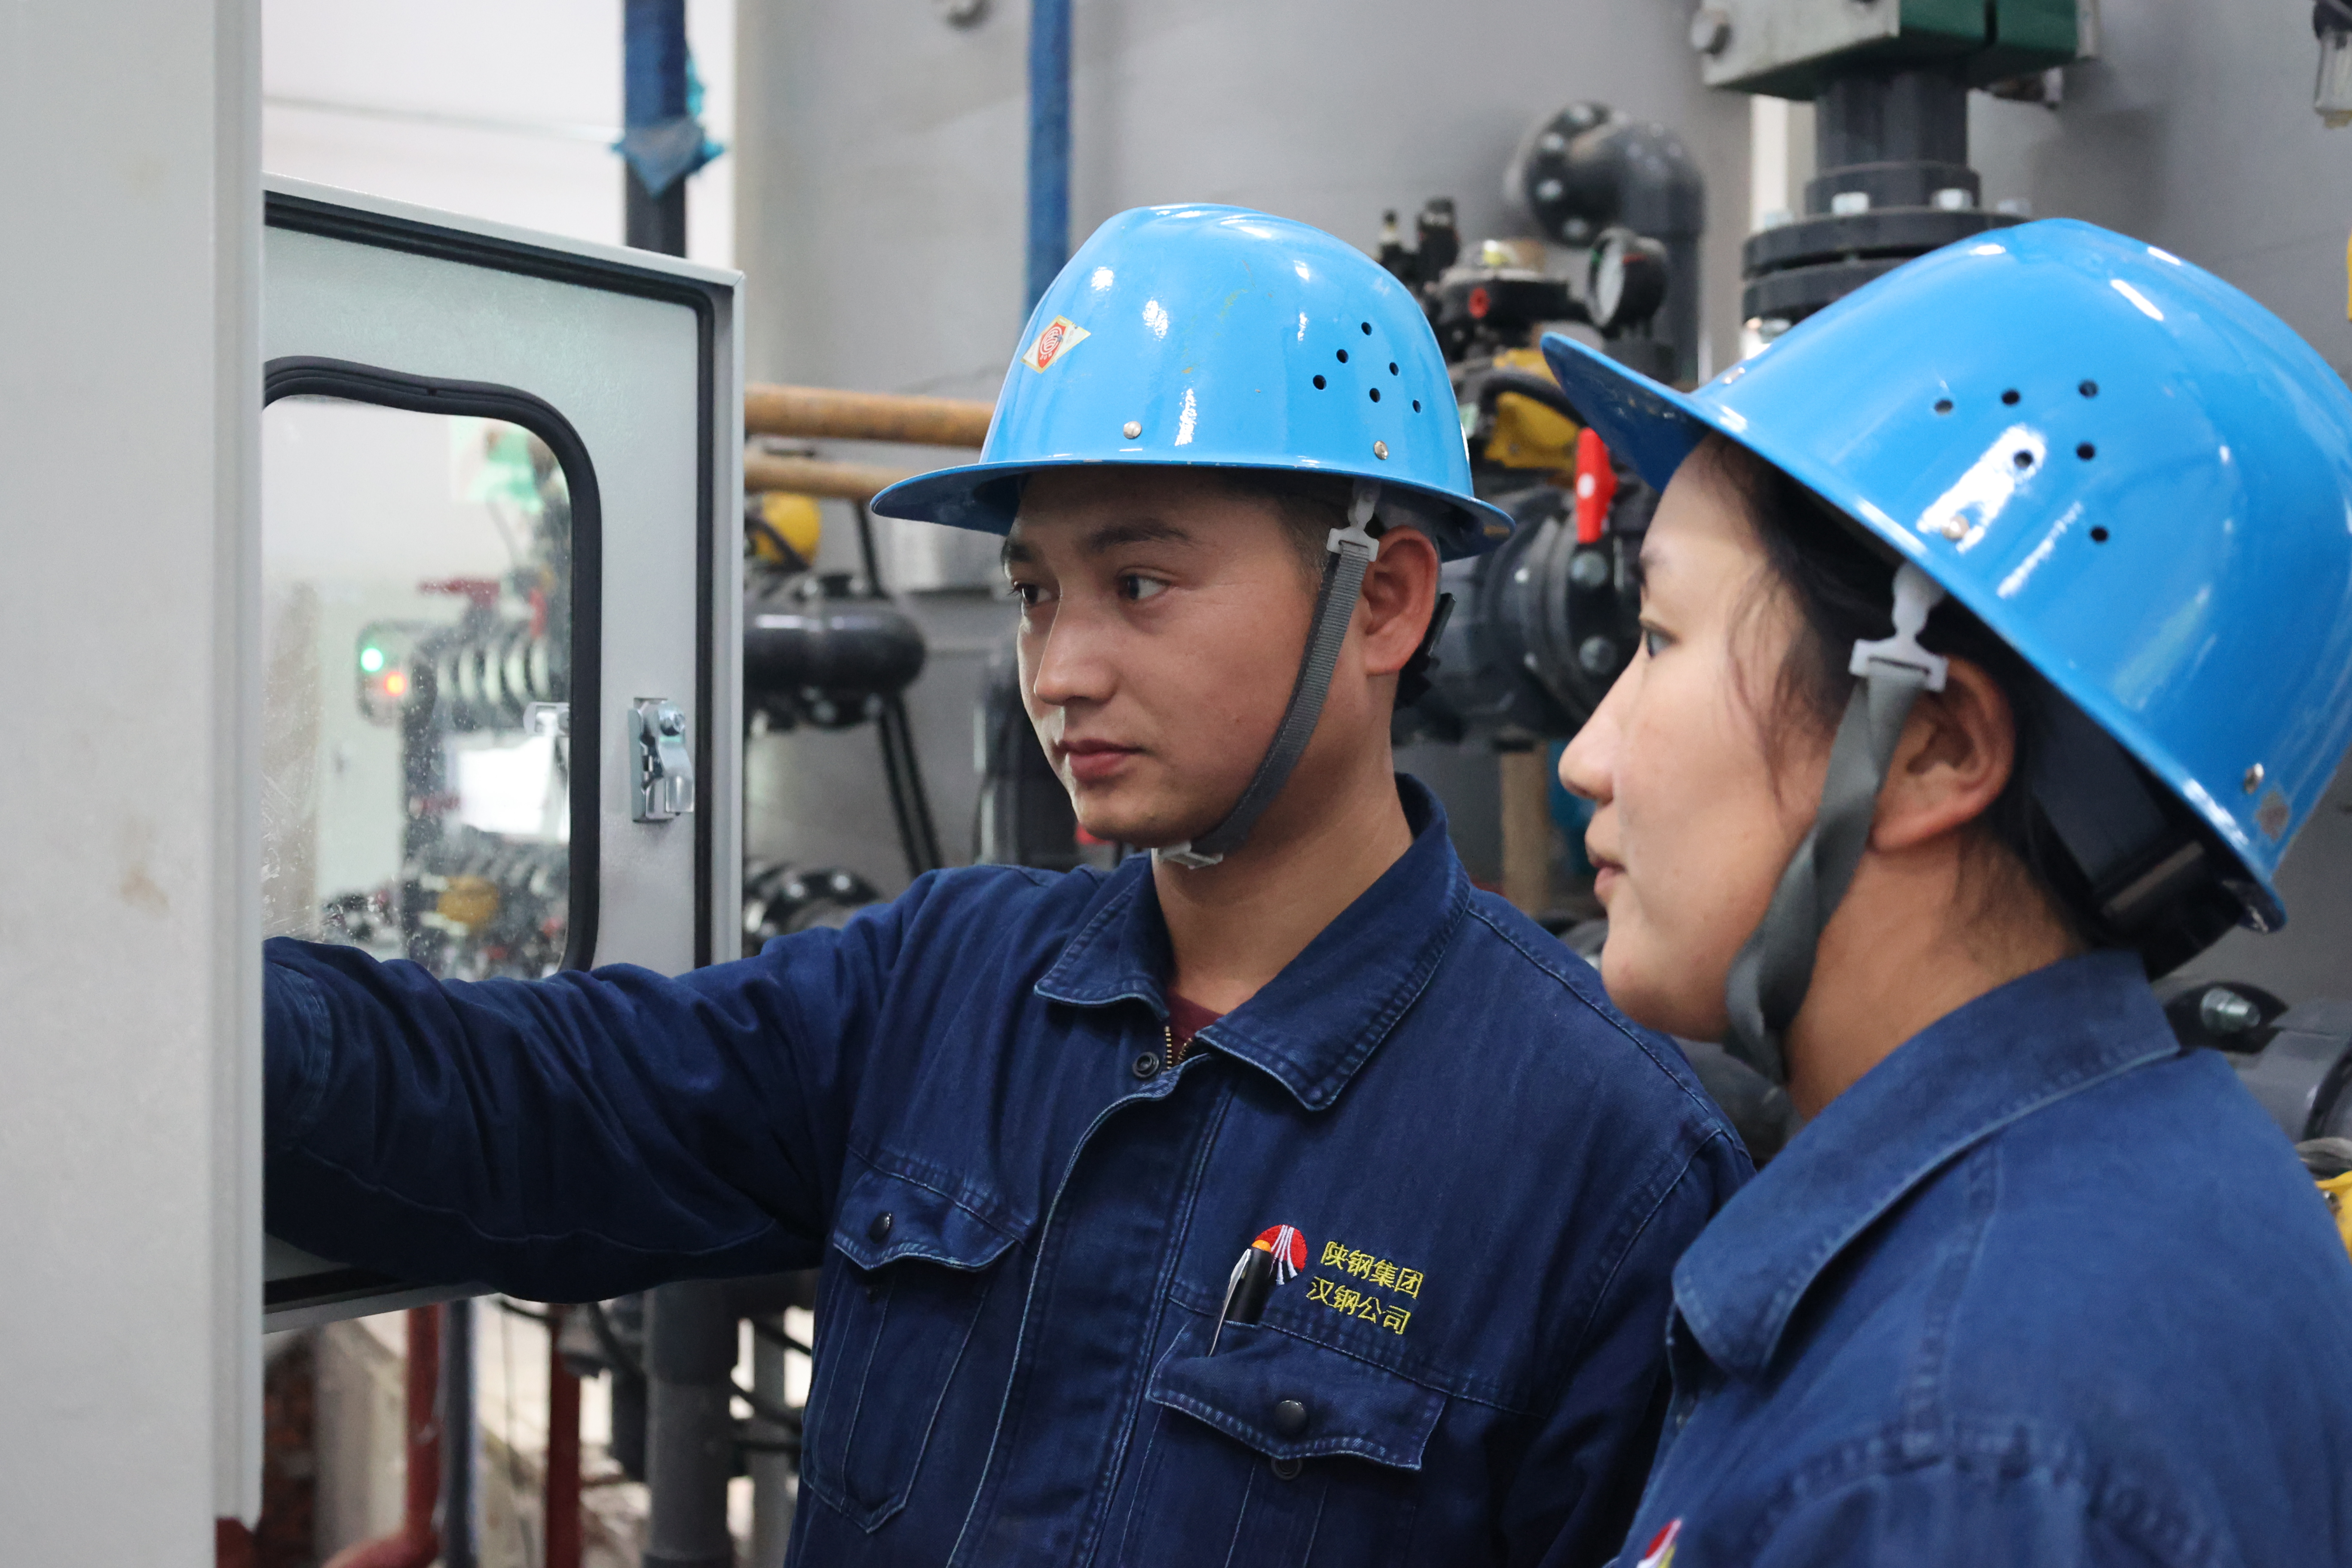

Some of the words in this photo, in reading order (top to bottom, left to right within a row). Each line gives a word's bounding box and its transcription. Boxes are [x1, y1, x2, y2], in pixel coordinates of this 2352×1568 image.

[1320, 1241, 1424, 1298] 陕钢集团
[1306, 1277, 1411, 1334] 汉钢公司
